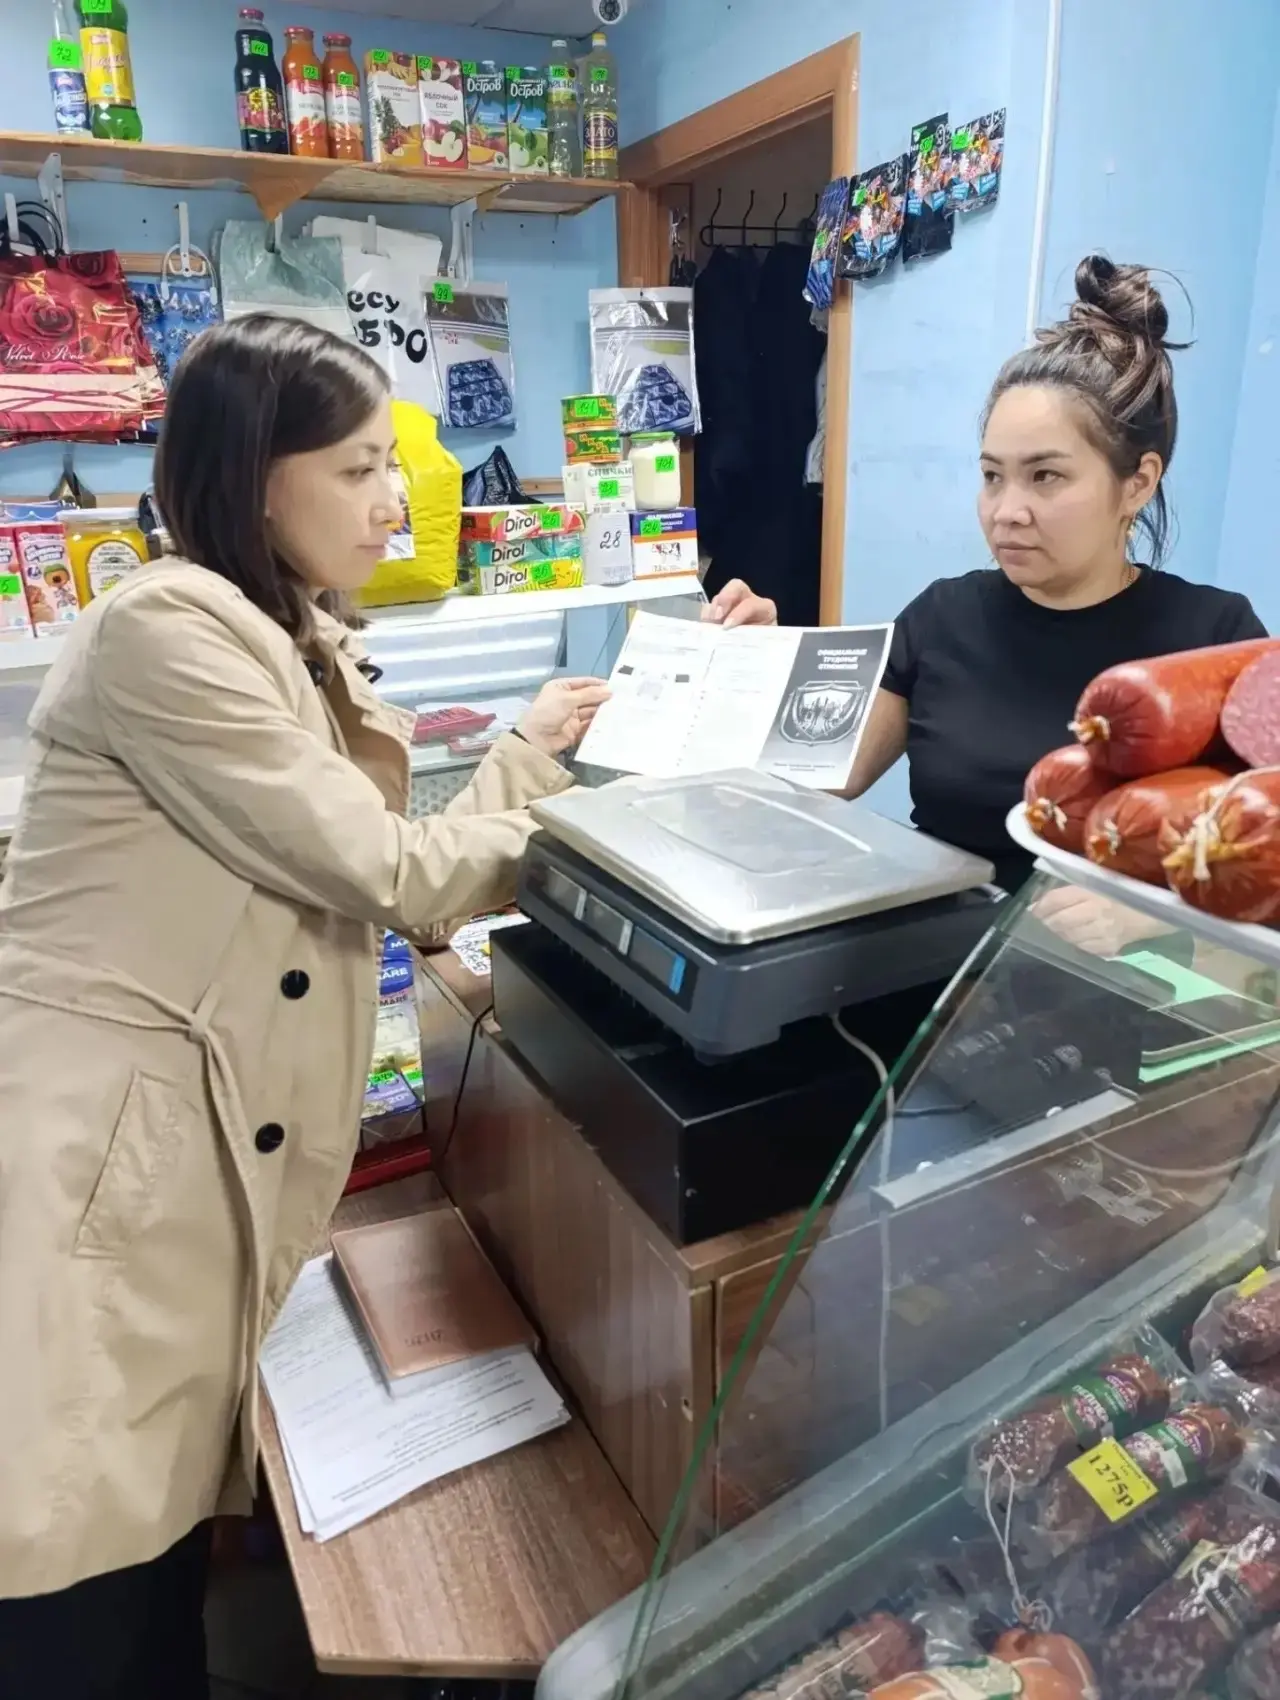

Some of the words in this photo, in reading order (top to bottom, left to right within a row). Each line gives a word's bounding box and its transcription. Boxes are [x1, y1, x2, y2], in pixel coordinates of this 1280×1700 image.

[466, 78, 503, 94] Остров
[510, 83, 544, 99] Остров
[436, 287, 449, 301] 99
[504, 512, 538, 533] Dirol
[599, 530, 622, 550] 28
[491, 543, 526, 563] Dirol
[494, 568, 528, 587] Dirol
